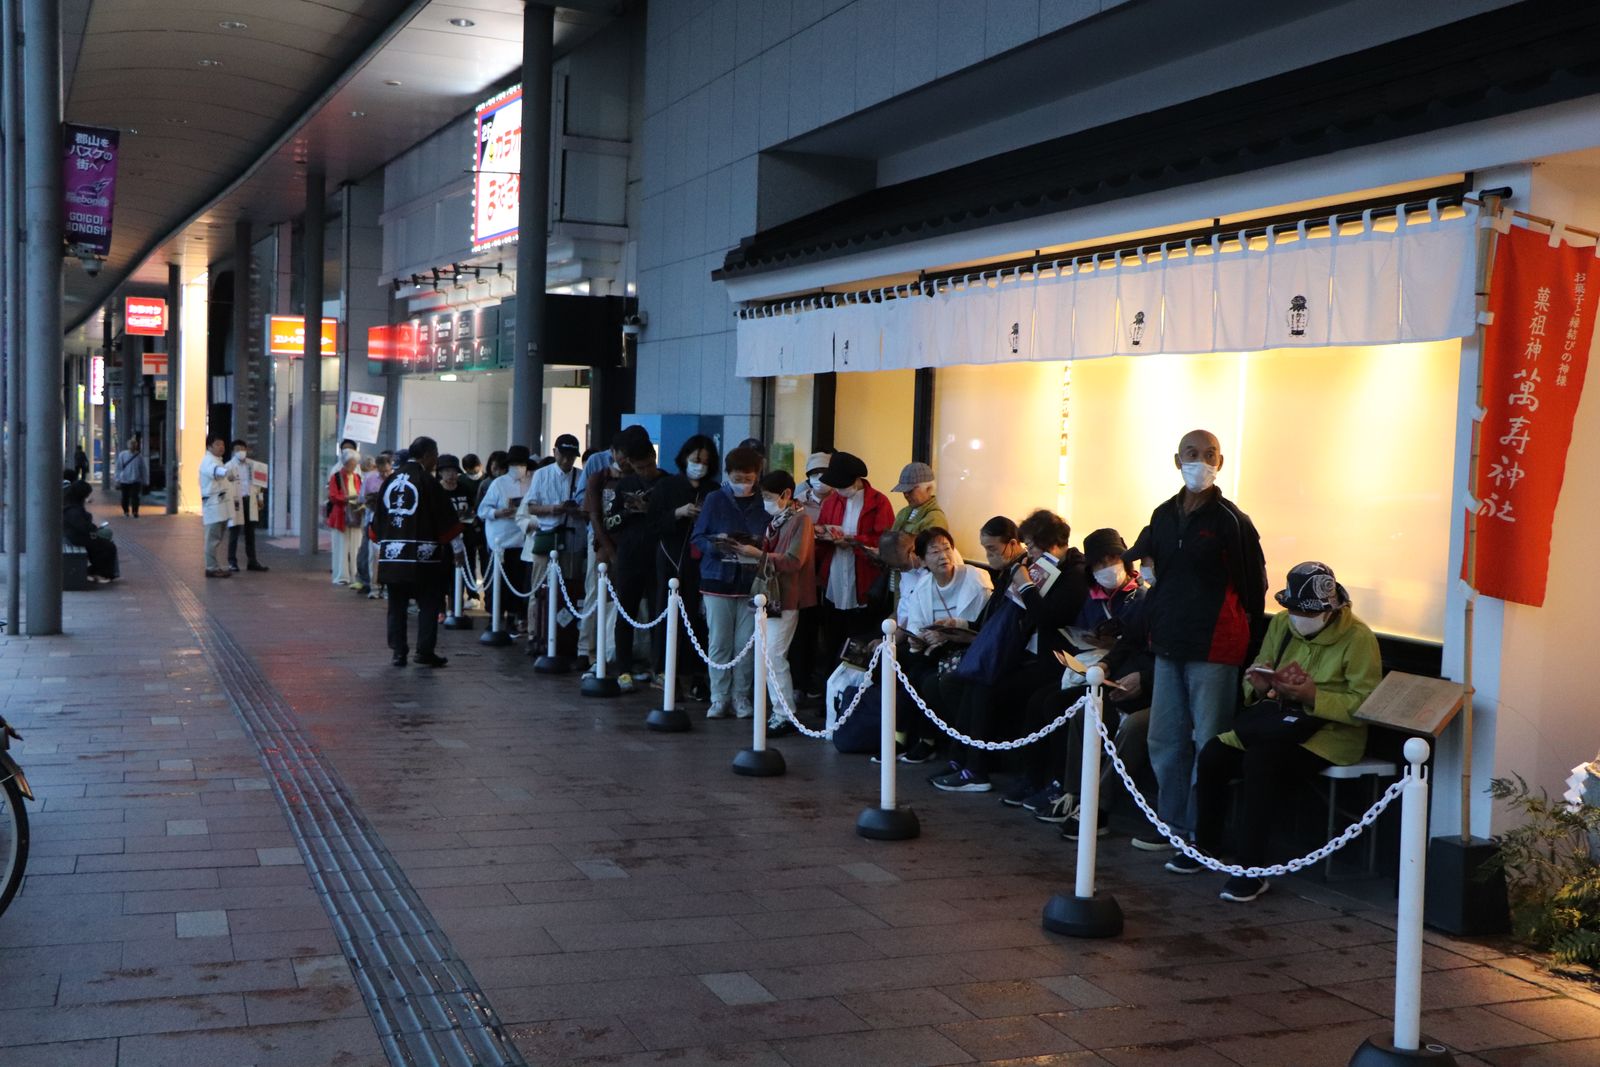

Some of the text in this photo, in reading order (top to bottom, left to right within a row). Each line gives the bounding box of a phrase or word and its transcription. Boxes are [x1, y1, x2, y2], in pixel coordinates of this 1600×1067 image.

[75, 132, 109, 148] 郡山を
[70, 145, 113, 161] バスケの
[1524, 286, 1551, 362] 菓祖神
